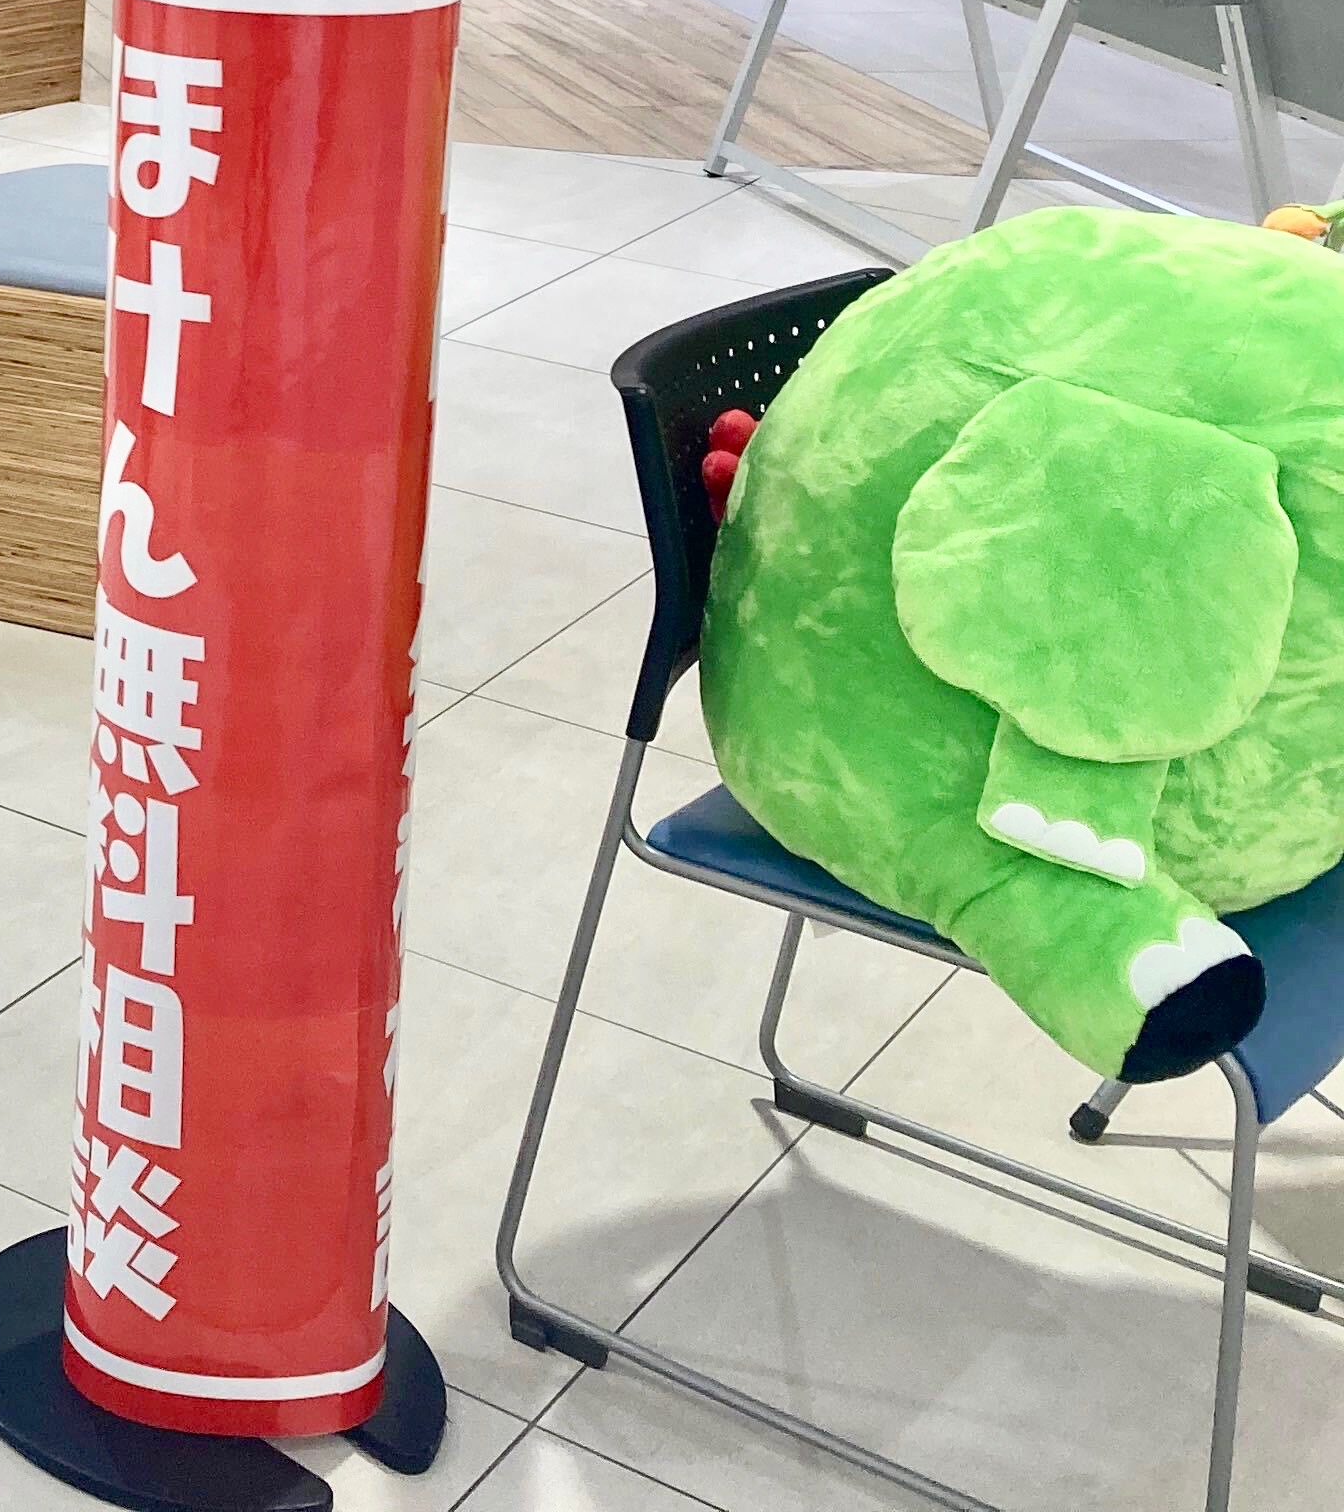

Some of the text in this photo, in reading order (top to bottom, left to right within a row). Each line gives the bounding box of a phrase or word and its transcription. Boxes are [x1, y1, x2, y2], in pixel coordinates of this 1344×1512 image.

[65, 31, 224, 1322] ほけん無料相談
